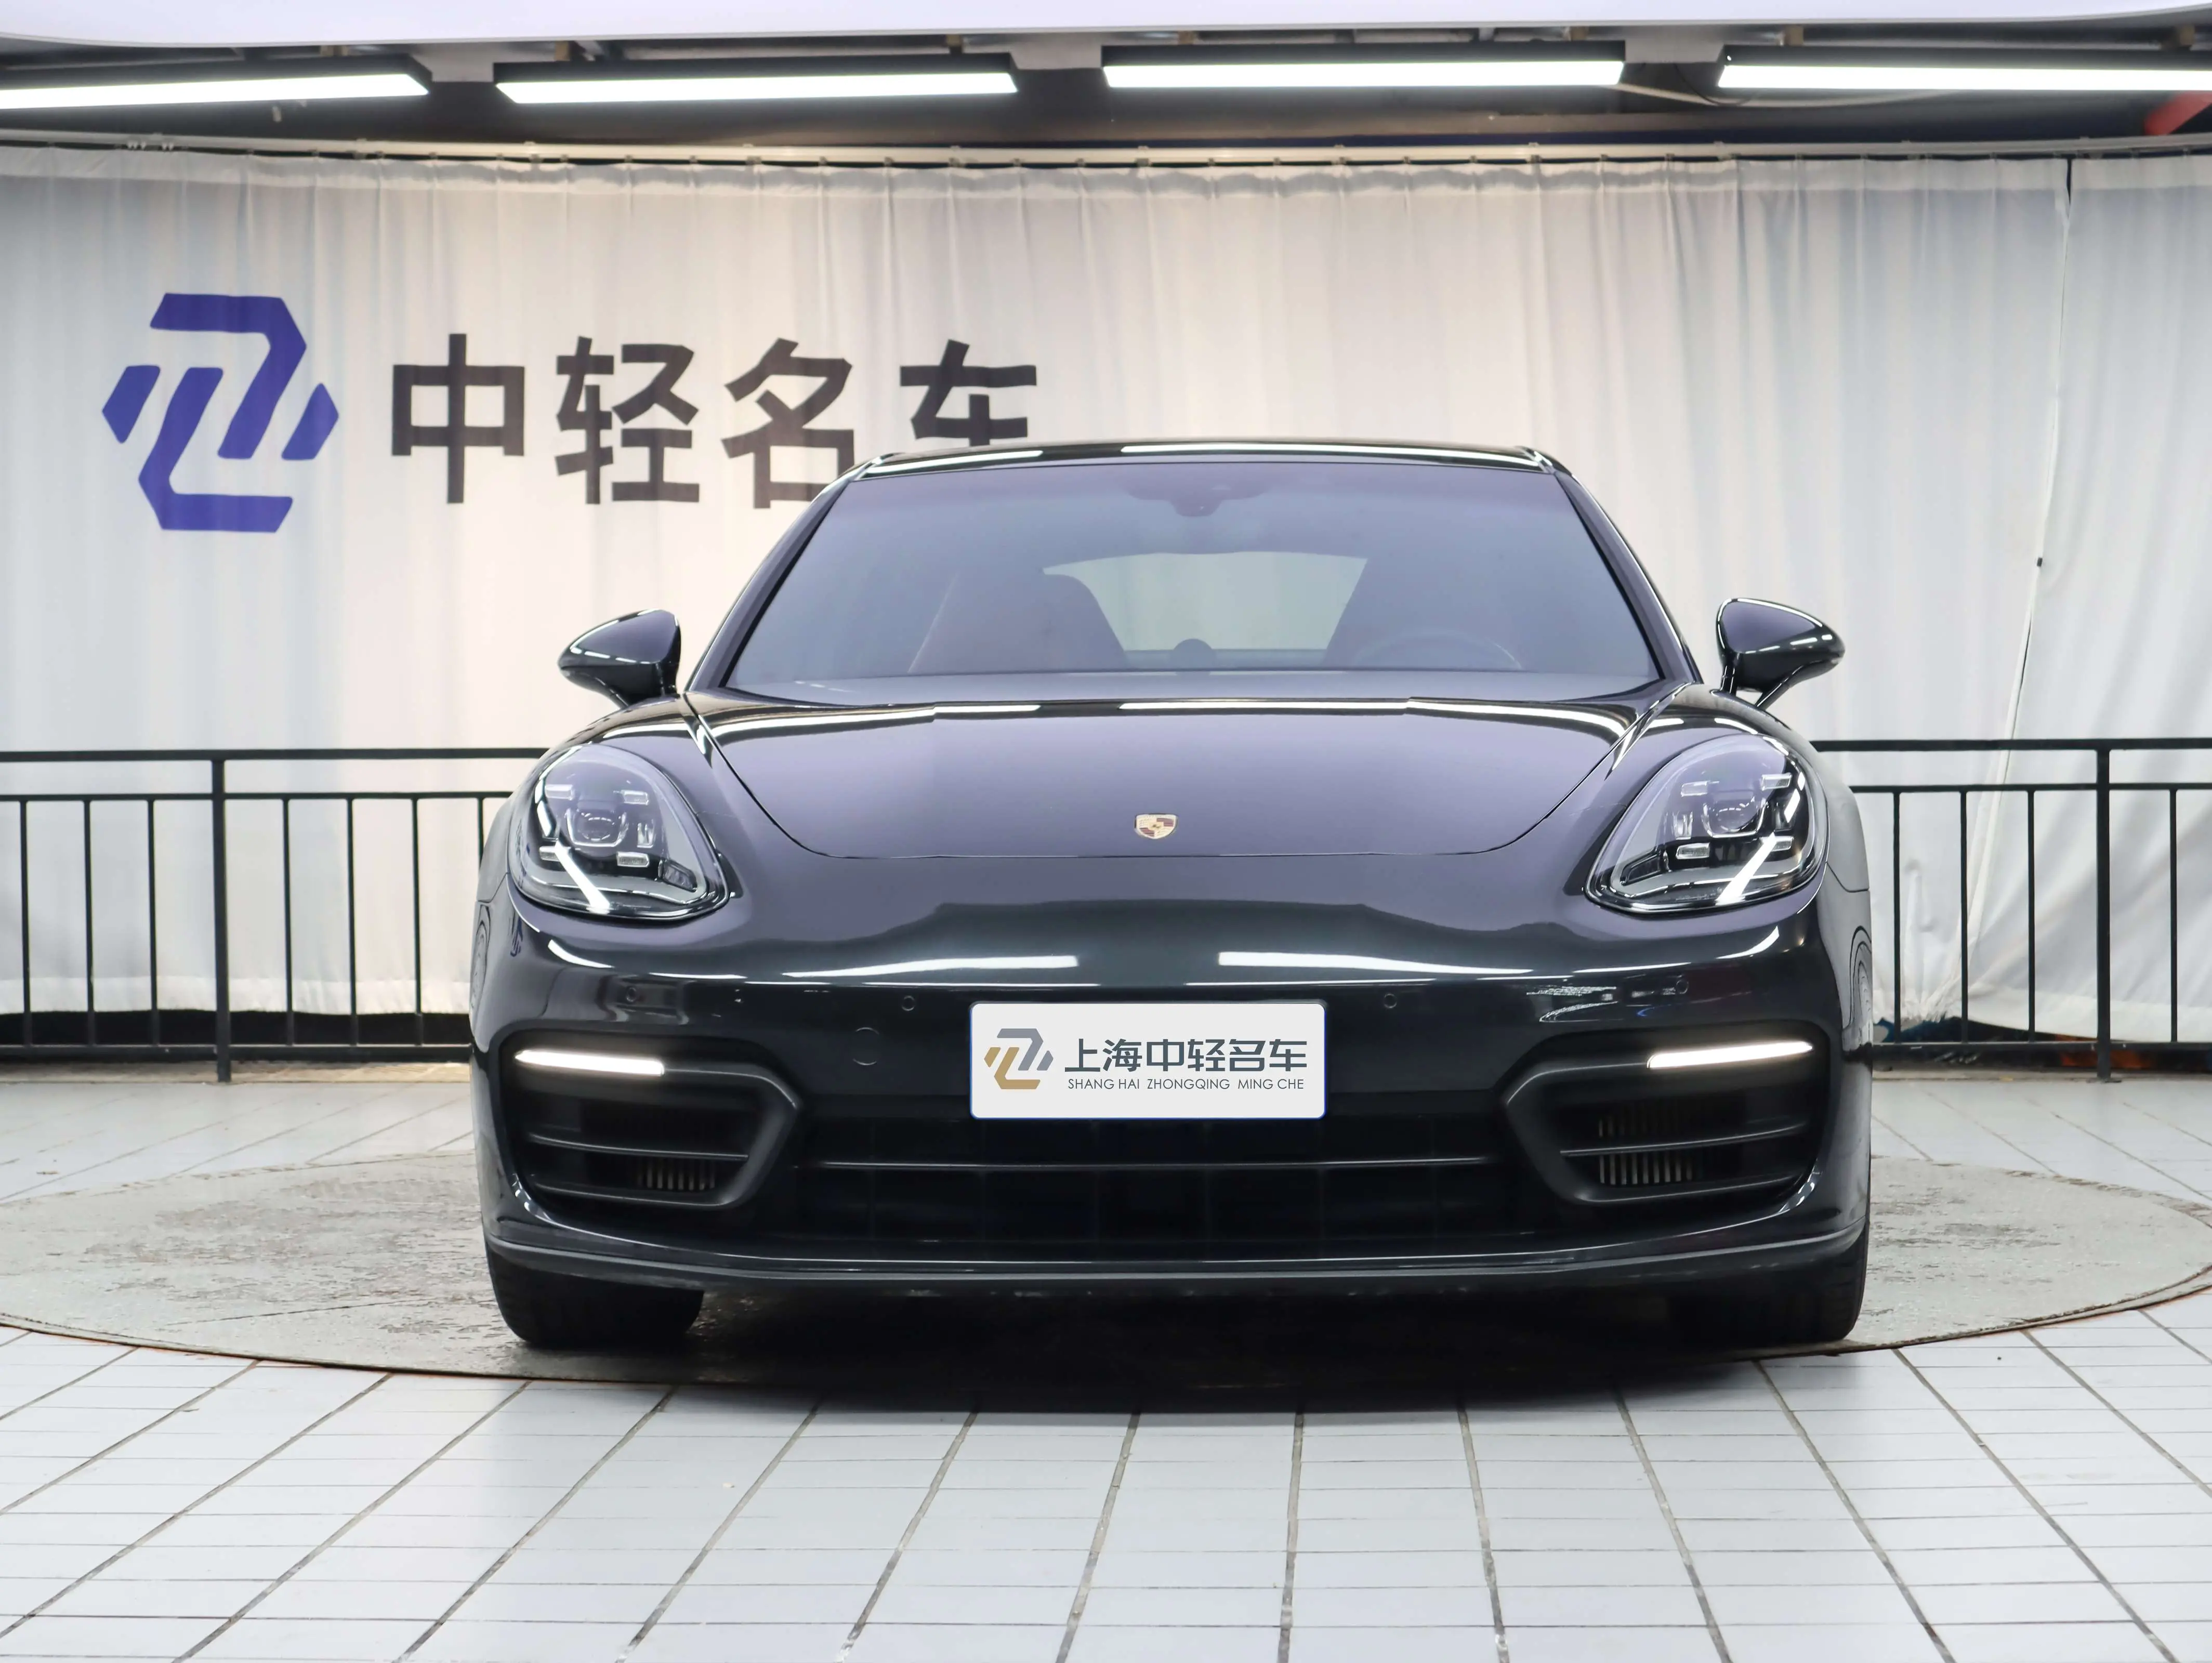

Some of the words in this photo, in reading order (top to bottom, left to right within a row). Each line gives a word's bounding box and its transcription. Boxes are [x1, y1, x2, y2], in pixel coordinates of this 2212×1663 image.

[392, 333, 1037, 509] 中轻名车
[1064, 1038, 1308, 1072] 上海中轻名车
[1068, 1078, 1115, 1090] SHANG
[1118, 1078, 1140, 1089] HAI
[1147, 1078, 1230, 1090] ZHONGQING
[1237, 1078, 1273, 1090] MING
[1277, 1078, 1304, 1090] CHE
